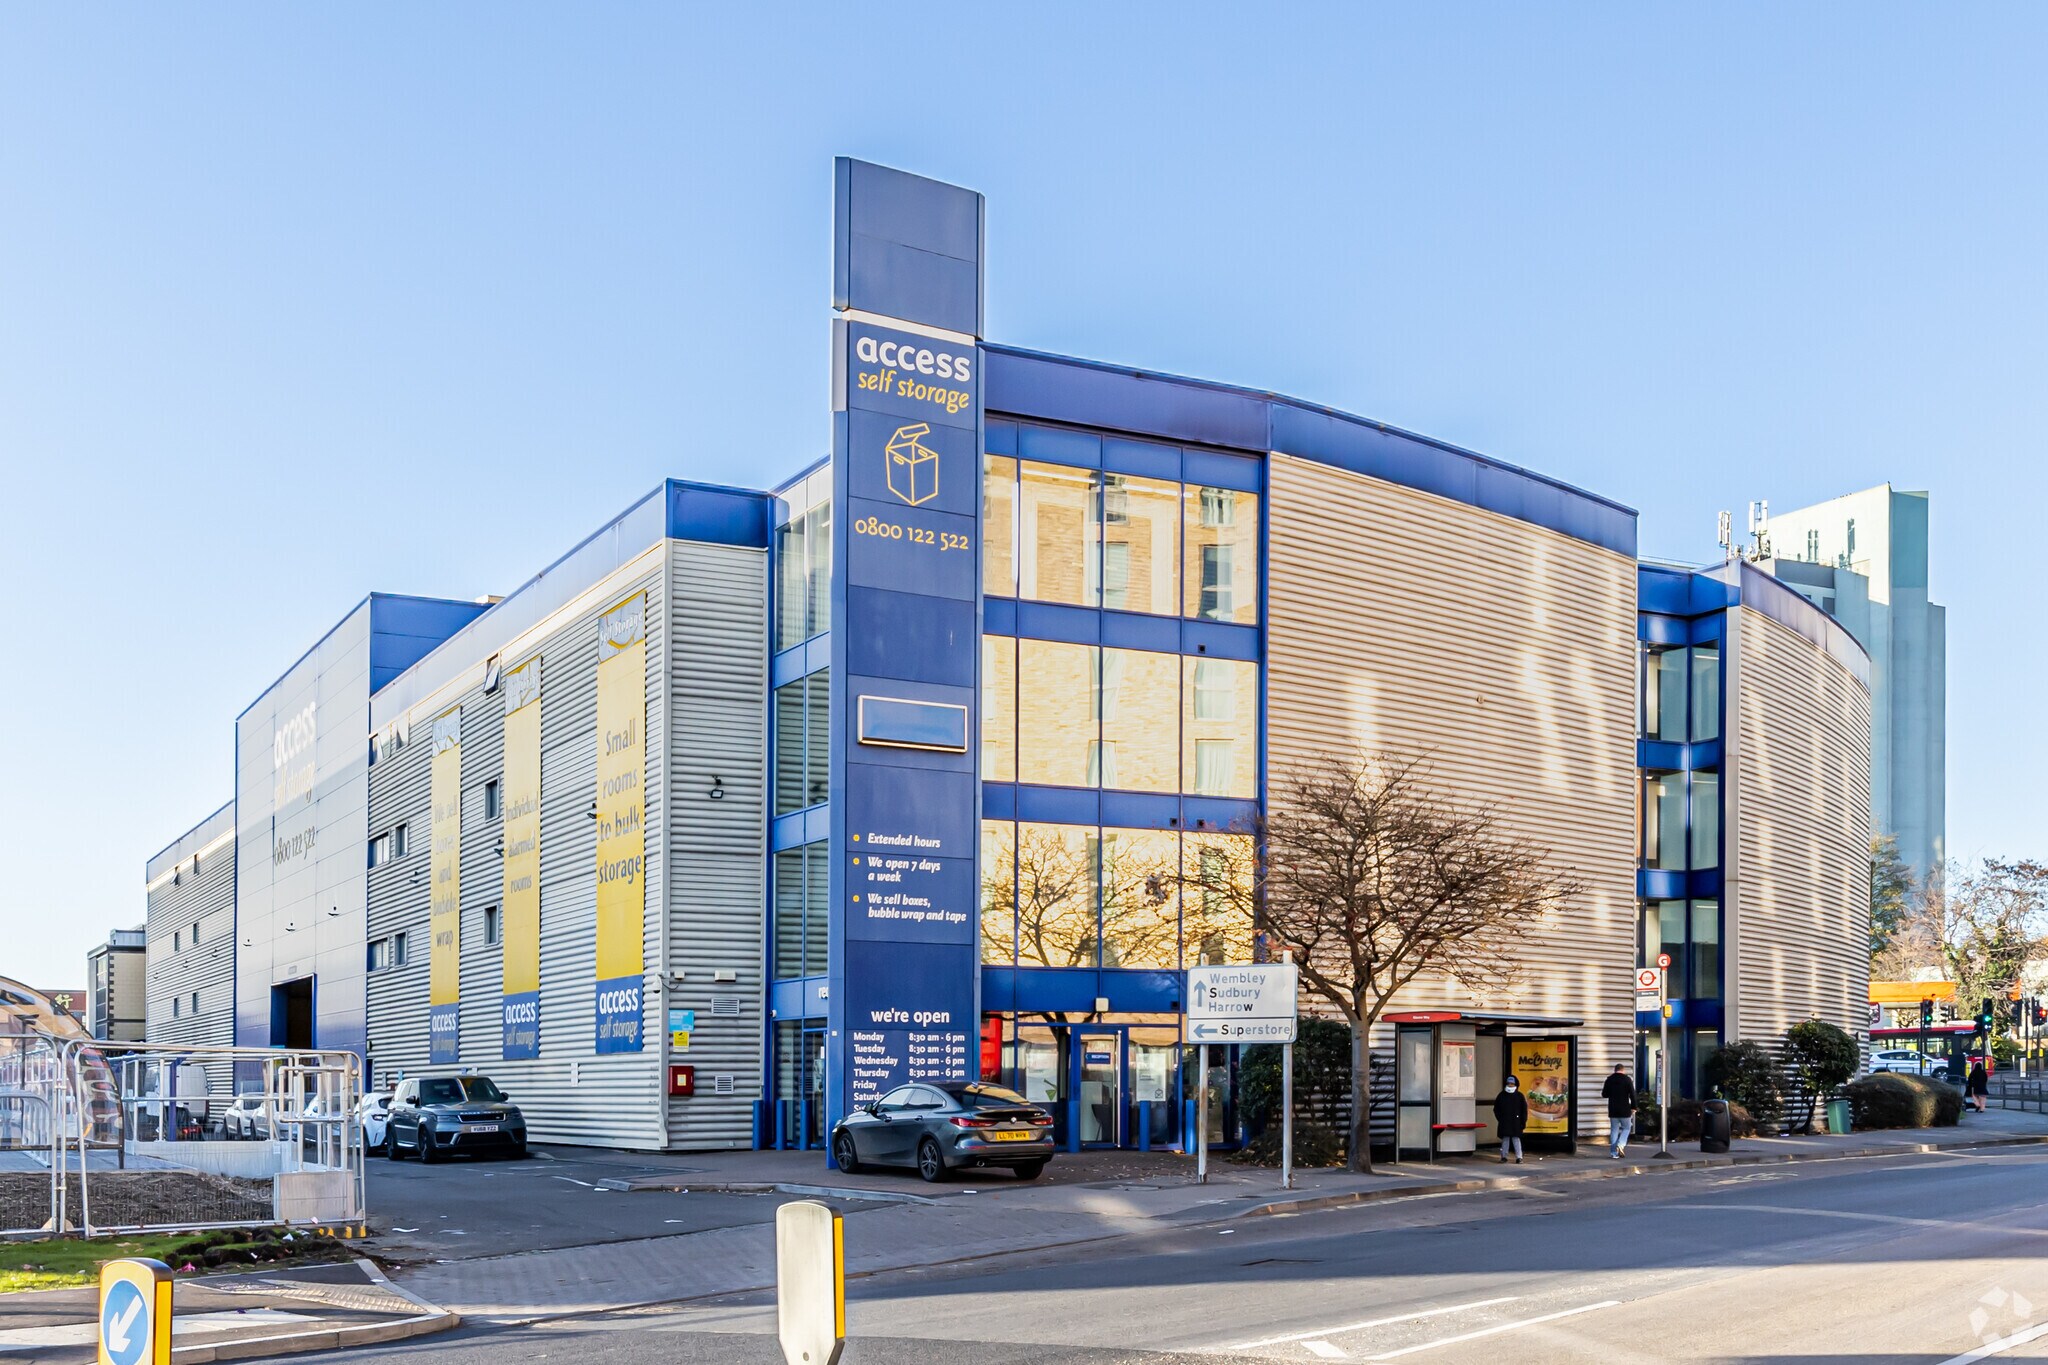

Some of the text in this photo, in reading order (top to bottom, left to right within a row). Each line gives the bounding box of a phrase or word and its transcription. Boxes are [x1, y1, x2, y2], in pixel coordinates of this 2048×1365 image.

[856, 336, 970, 382] access
[858, 369, 970, 413] self storage
[855, 517, 968, 550] 0800 122 522
[274, 701, 316, 770] access
[606, 718, 636, 756] Small
[602, 768, 637, 799] rooms
[600, 805, 640, 842] to bulk
[274, 826, 315, 866] 0800 122 522
[868, 833, 941, 848] Extended hours
[599, 854, 641, 884] storage
[868, 856, 941, 873] We open 7 days
[511, 875, 532, 894] rooms
[877, 871, 901, 882] week
[868, 893, 931, 908] We sell boxes,
[868, 907, 967, 924] bubble wrap and tape
[436, 930, 453, 951] wrap
[1658, 956, 1668, 966] G
[1210, 973, 1266, 985] Wembley
[599, 988, 638, 1014] access
[1209, 988, 1260, 999] Sudbury
[506, 1002, 536, 1024] access
[1209, 1002, 1253, 1012] Harrow
[432, 1013, 456, 1032] access
[871, 1008, 950, 1027] we're open
[600, 1016, 638, 1043] self storage
[853, 1032, 884, 1043] Monday
[909, 1033, 926, 1042] 8:30
[945, 1033, 951, 1041] 6
[952, 1035, 965, 1043] pm
[1221, 1025, 1290, 1037] Superstore
[854, 1044, 885, 1054] Tuesday
[909, 1044, 926, 1054] 8:30
[945, 1044, 951, 1053] 6
[952, 1046, 965, 1055] pm
[854, 1056, 898, 1066] Wednesday
[909, 1056, 926, 1065] 8:30
[945, 1056, 951, 1065] 6
[952, 1058, 965, 1066] pm
[1518, 1052, 1562, 1069] McCrispy
[854, 1068, 889, 1078] Thursday
[909, 1068, 926, 1077] 8:30
[945, 1068, 951, 1076] 6
[952, 1070, 965, 1078] pm
[853, 1080, 877, 1090] Friday
[854, 1092, 883, 1101] Saturda
